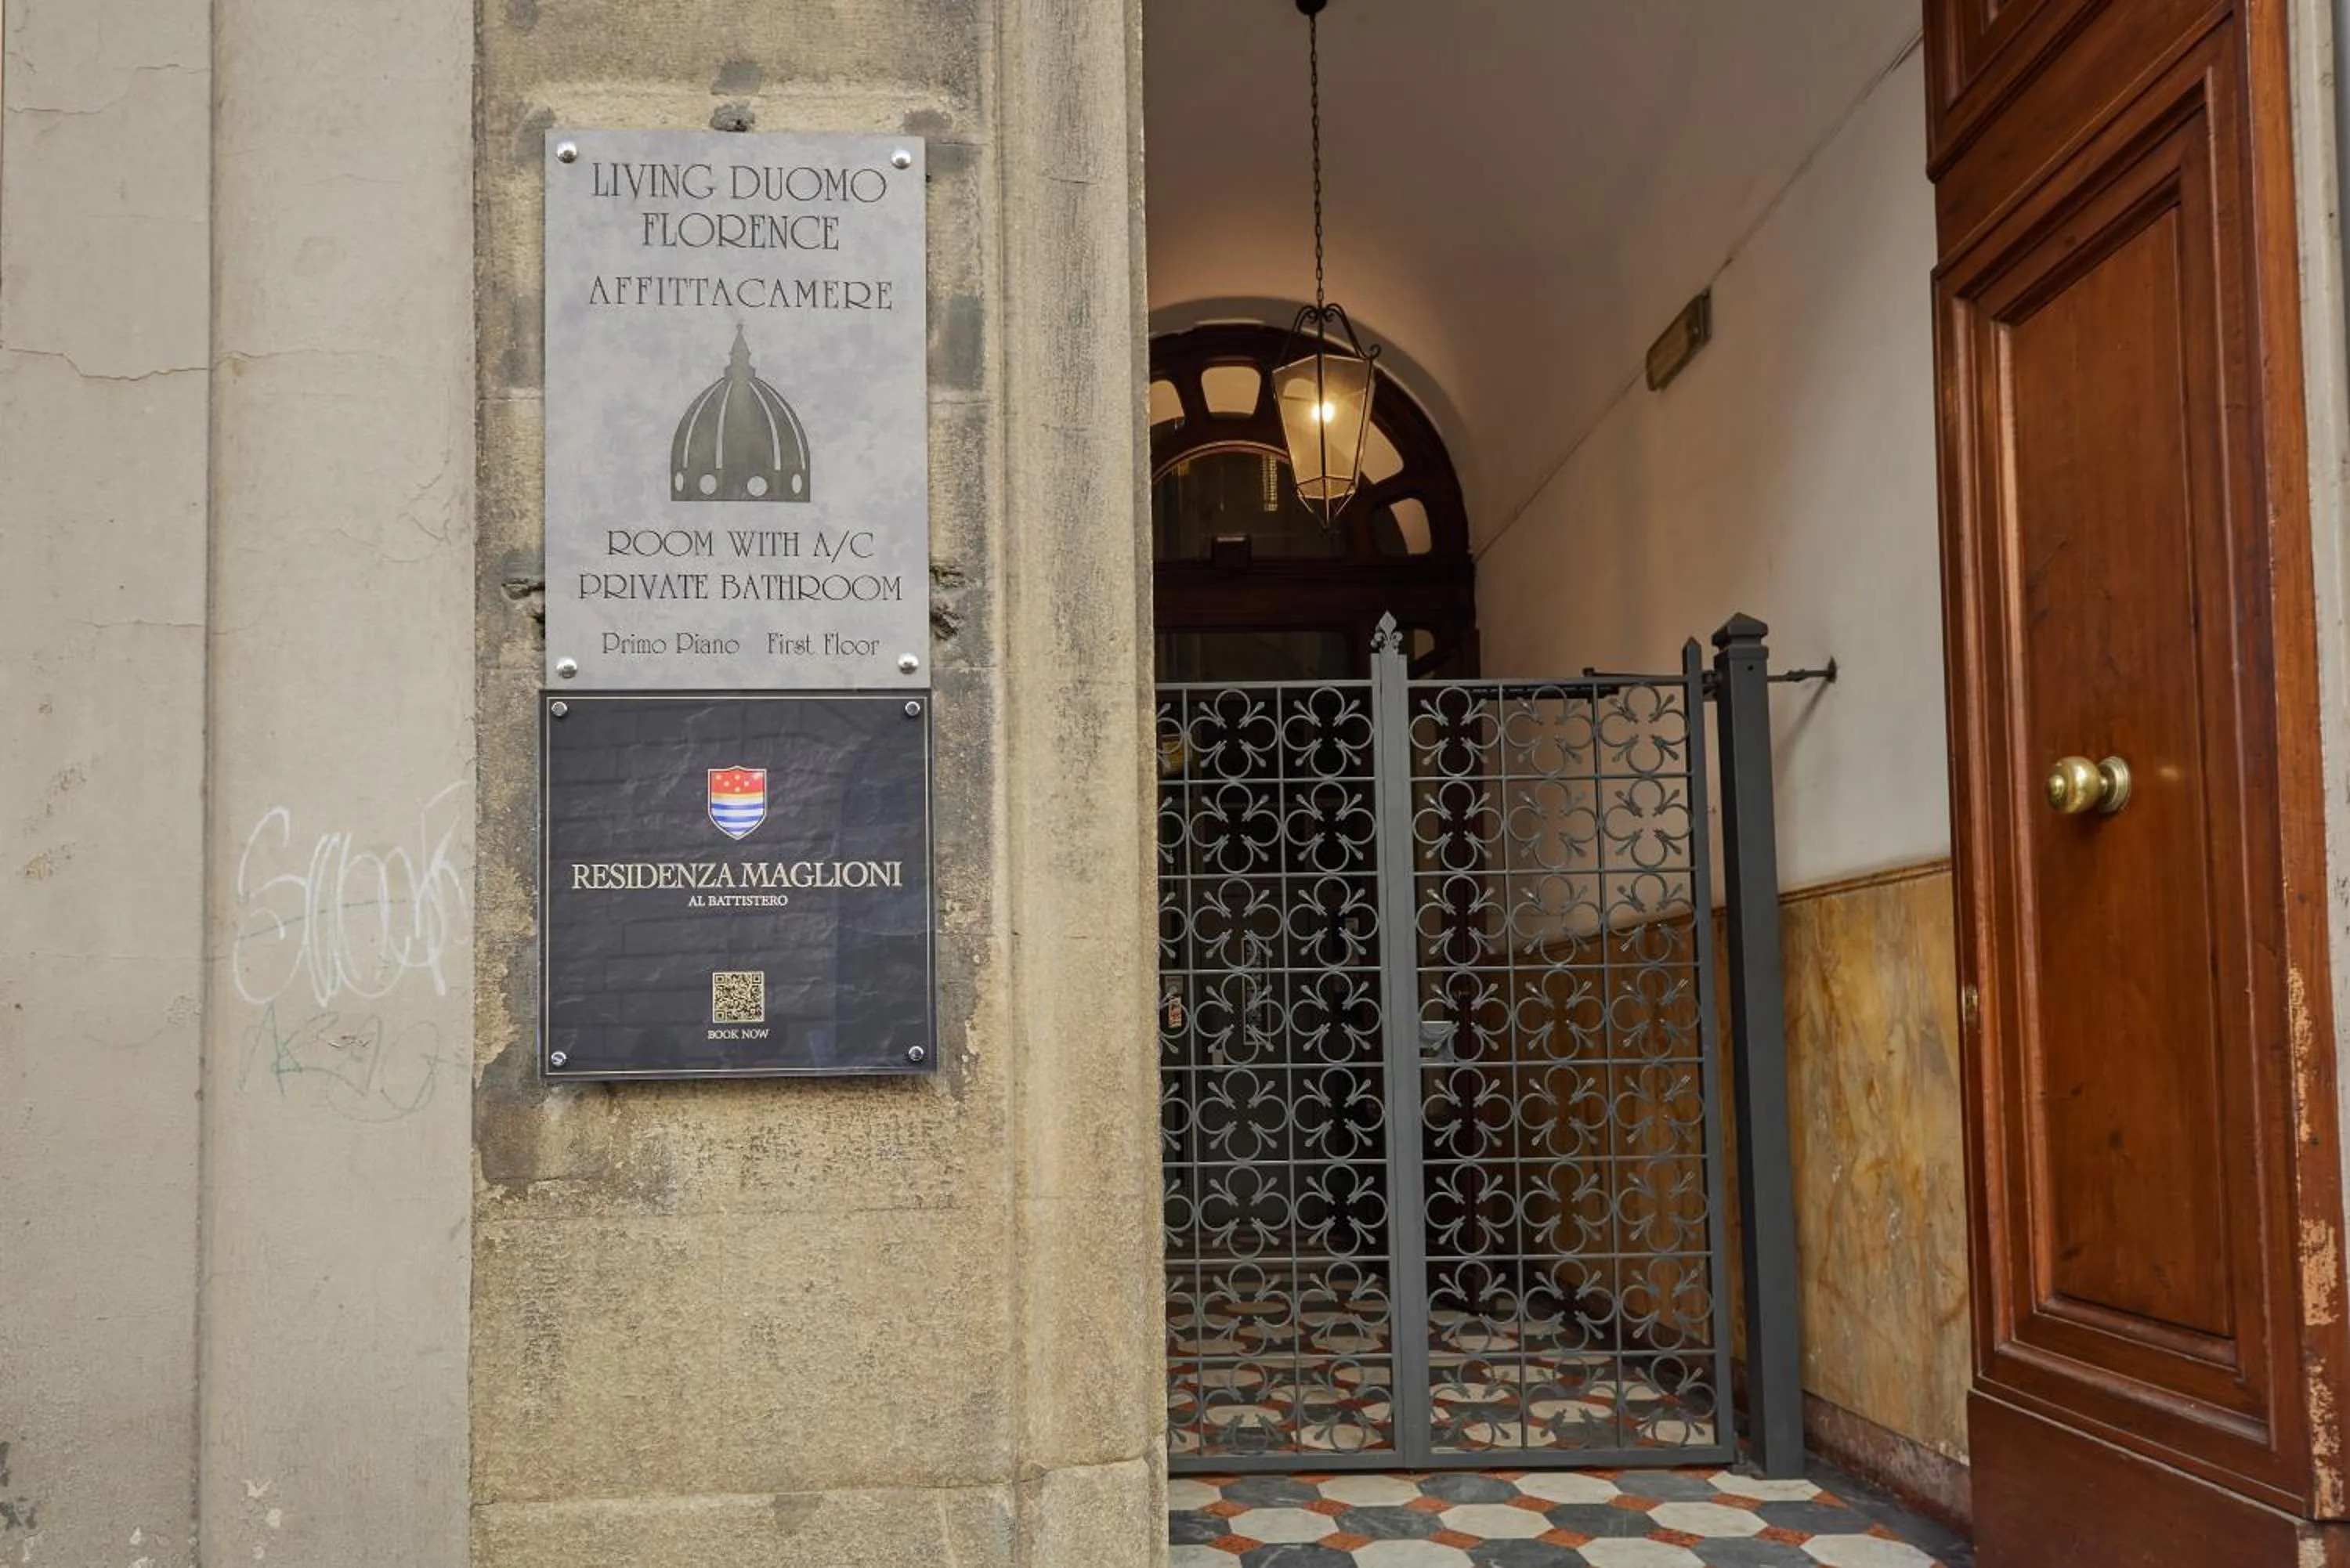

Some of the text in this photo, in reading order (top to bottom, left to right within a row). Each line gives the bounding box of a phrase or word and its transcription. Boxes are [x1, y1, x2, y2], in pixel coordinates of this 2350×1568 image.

[591, 162, 888, 203] LIVING DUOMO
[642, 212, 840, 251] FLORENCE
[589, 276, 893, 310] AFFITTACAMERE
[607, 529, 875, 563] ROOM WITH A/C
[578, 573, 903, 601] PRIVATE BATHROOM
[602, 632, 880, 656] Primo Piano First Floor
[571, 861, 902, 890] RESIDENZA MAGLIONI
[688, 894, 789, 907] AL BATTISTERO
[707, 1028, 769, 1039] BOOK NOW
